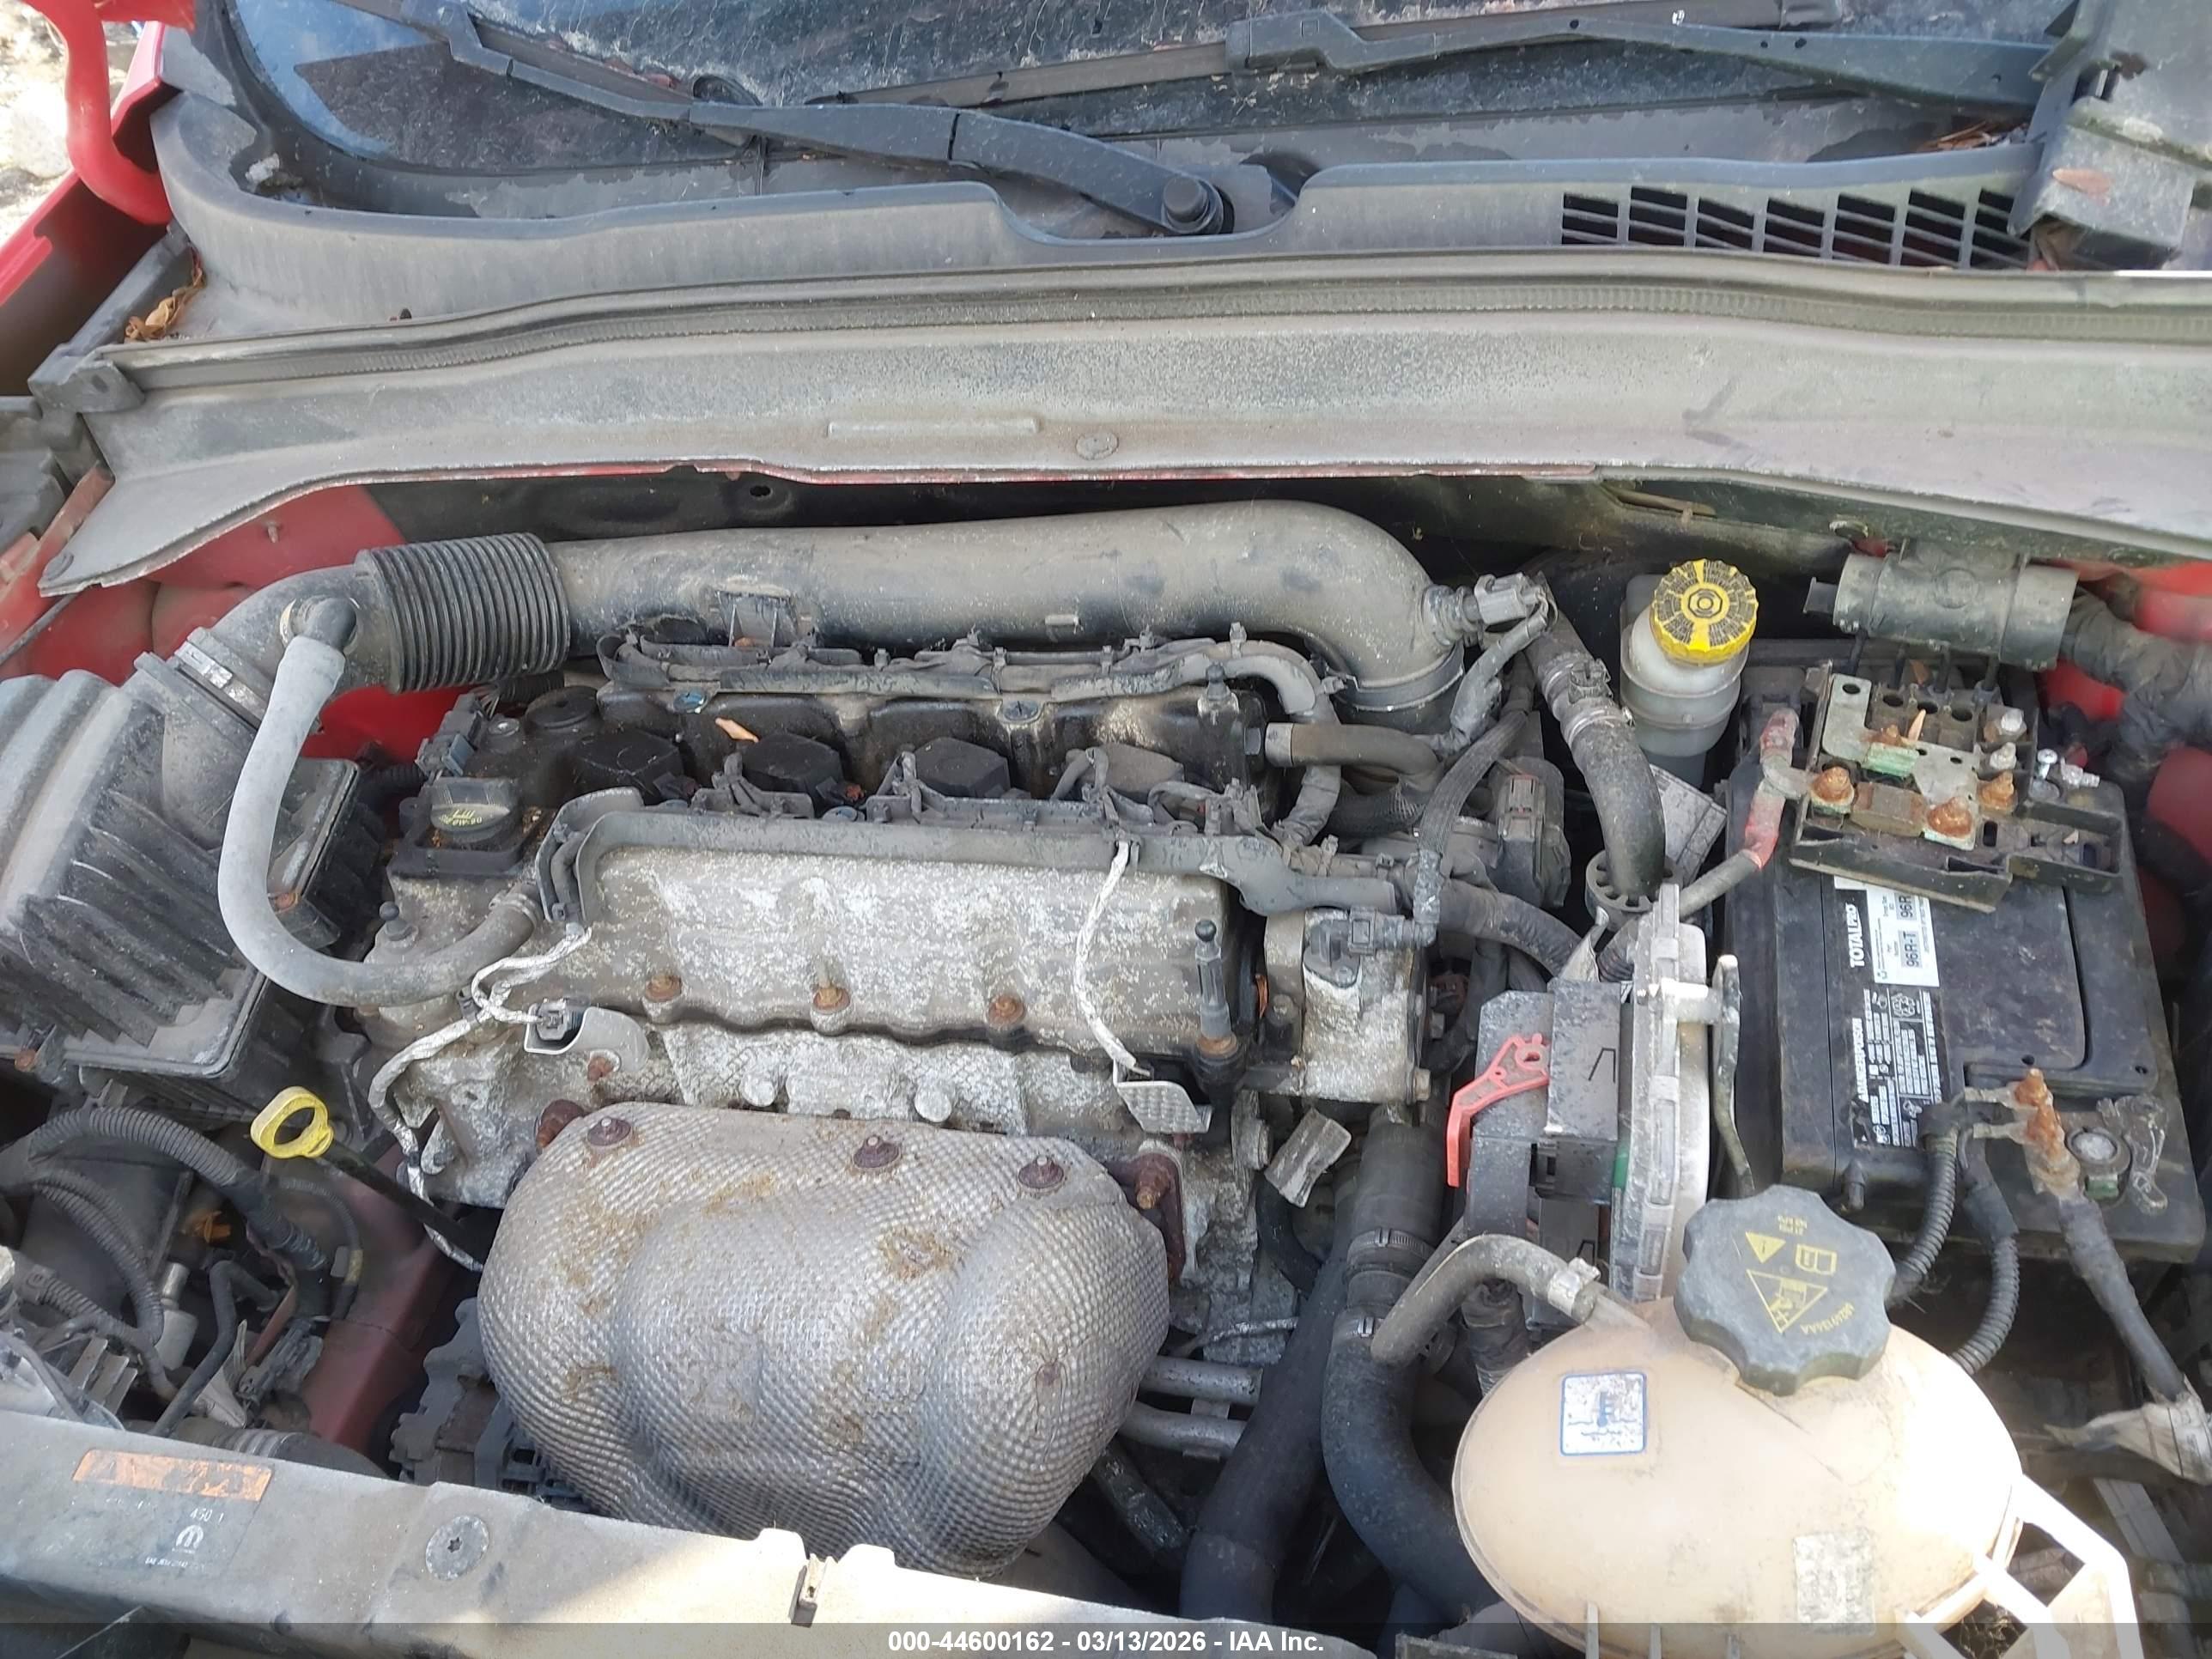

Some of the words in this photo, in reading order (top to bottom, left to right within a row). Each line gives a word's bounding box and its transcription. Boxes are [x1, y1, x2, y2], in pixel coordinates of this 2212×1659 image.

[1899, 894, 1913, 918] 96R
[1845, 902, 1865, 968] TOTALPRO
[1903, 930, 1920, 968] 96R-T
